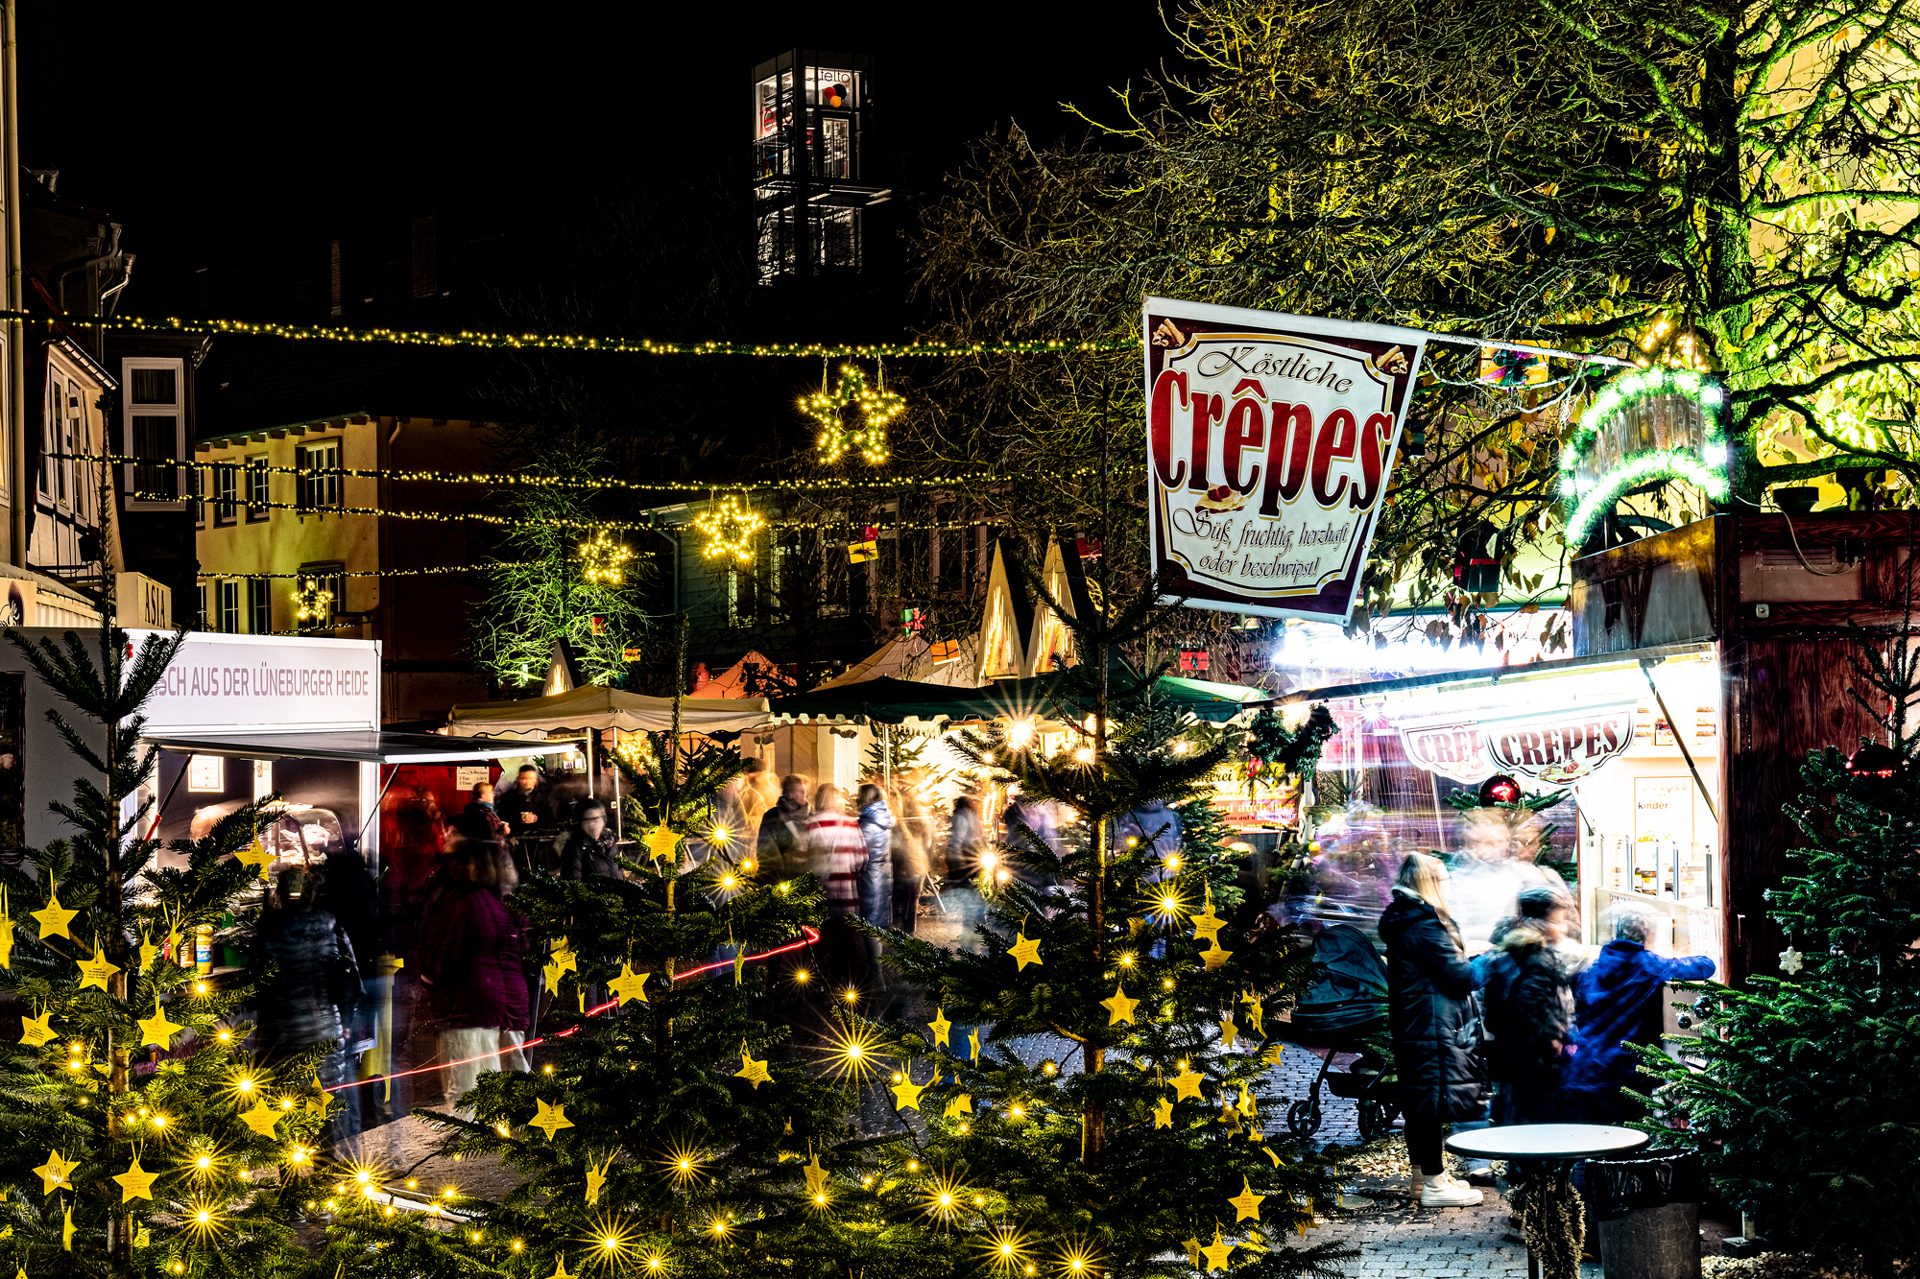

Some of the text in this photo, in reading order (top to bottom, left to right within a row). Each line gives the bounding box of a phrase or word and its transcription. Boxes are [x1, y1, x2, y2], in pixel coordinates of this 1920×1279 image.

[1197, 346, 1354, 394] Köstliche
[1151, 368, 1394, 520] Crêpes
[1172, 507, 1350, 555] Süß, fruchtig, herzhaft
[1199, 554, 1320, 584] oder beschwipst!
[145, 582, 166, 629] ASIA
[191, 667, 219, 697] AUS
[223, 668, 249, 697] DER
[253, 661, 333, 697] LÜNEBURGER
[336, 669, 369, 697] HEIDE
[1417, 723, 1485, 764] CRÊP
[1638, 802, 1668, 810] kinder
